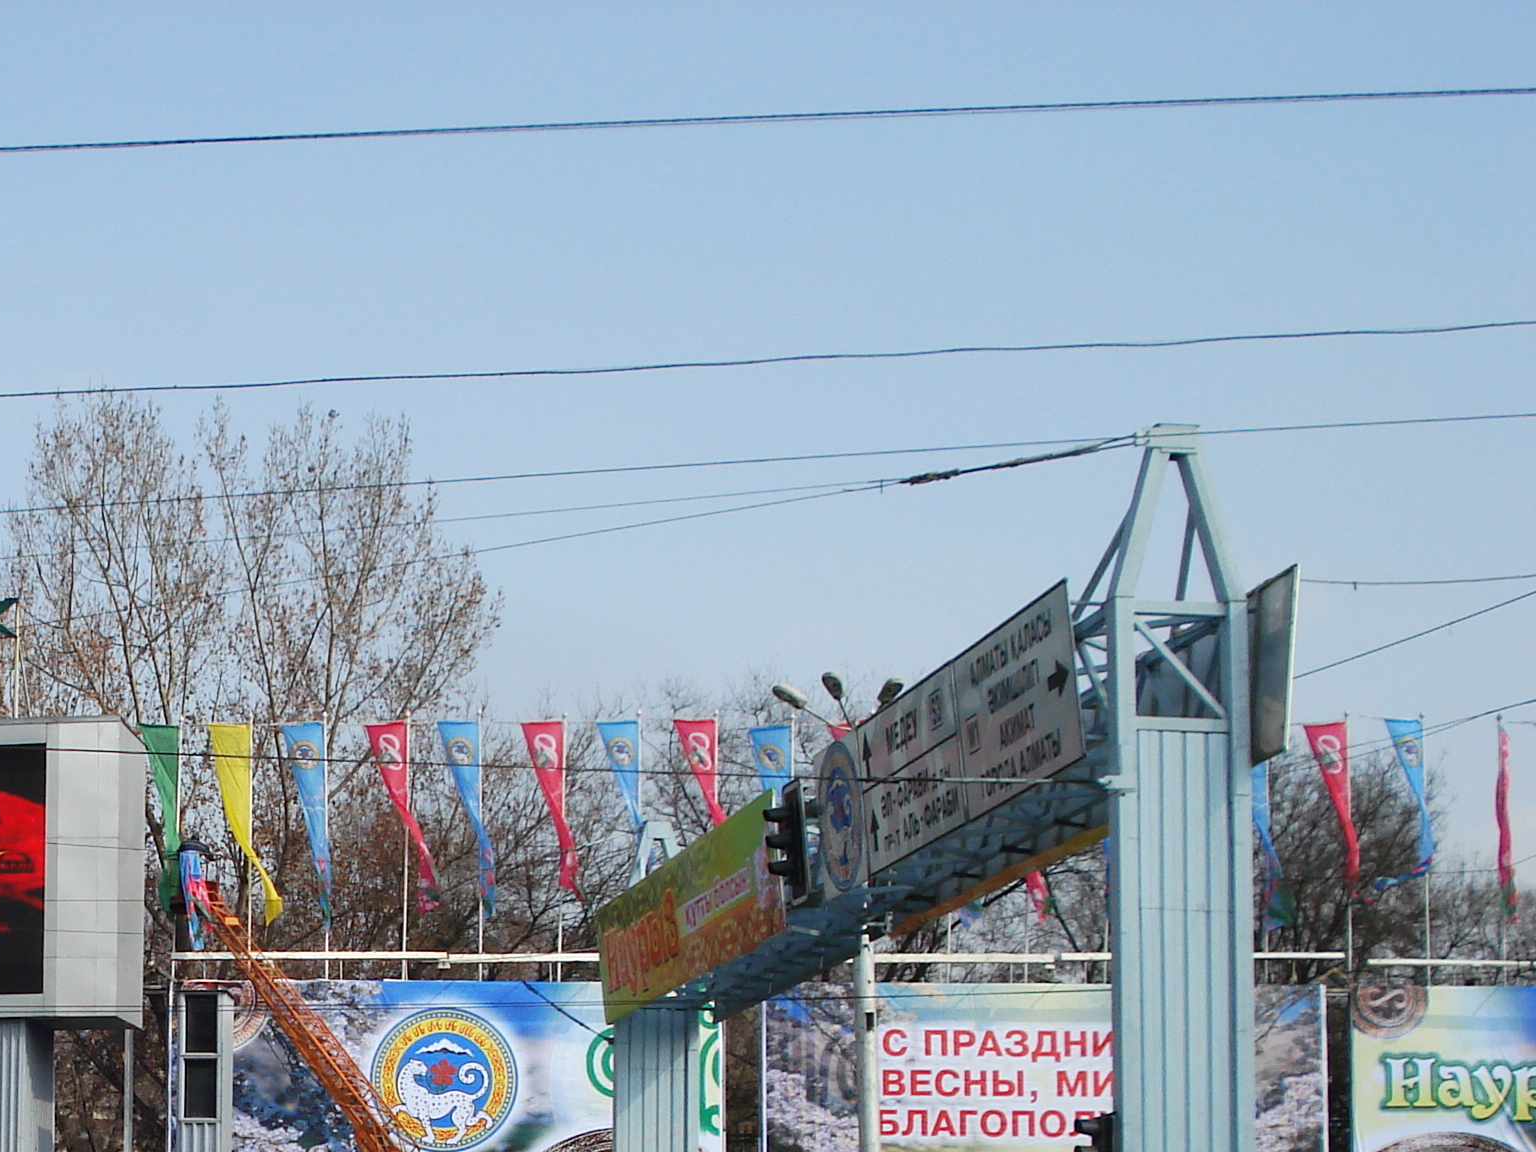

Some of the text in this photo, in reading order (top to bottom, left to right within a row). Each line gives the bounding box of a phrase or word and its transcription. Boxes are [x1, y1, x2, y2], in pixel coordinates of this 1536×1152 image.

[882, 1029, 1113, 1063] С ПРАЗДНИ
[882, 1069, 1113, 1103] ВЕСНЫ, МИ
[879, 1109, 1107, 1137] БЛАГОПО
